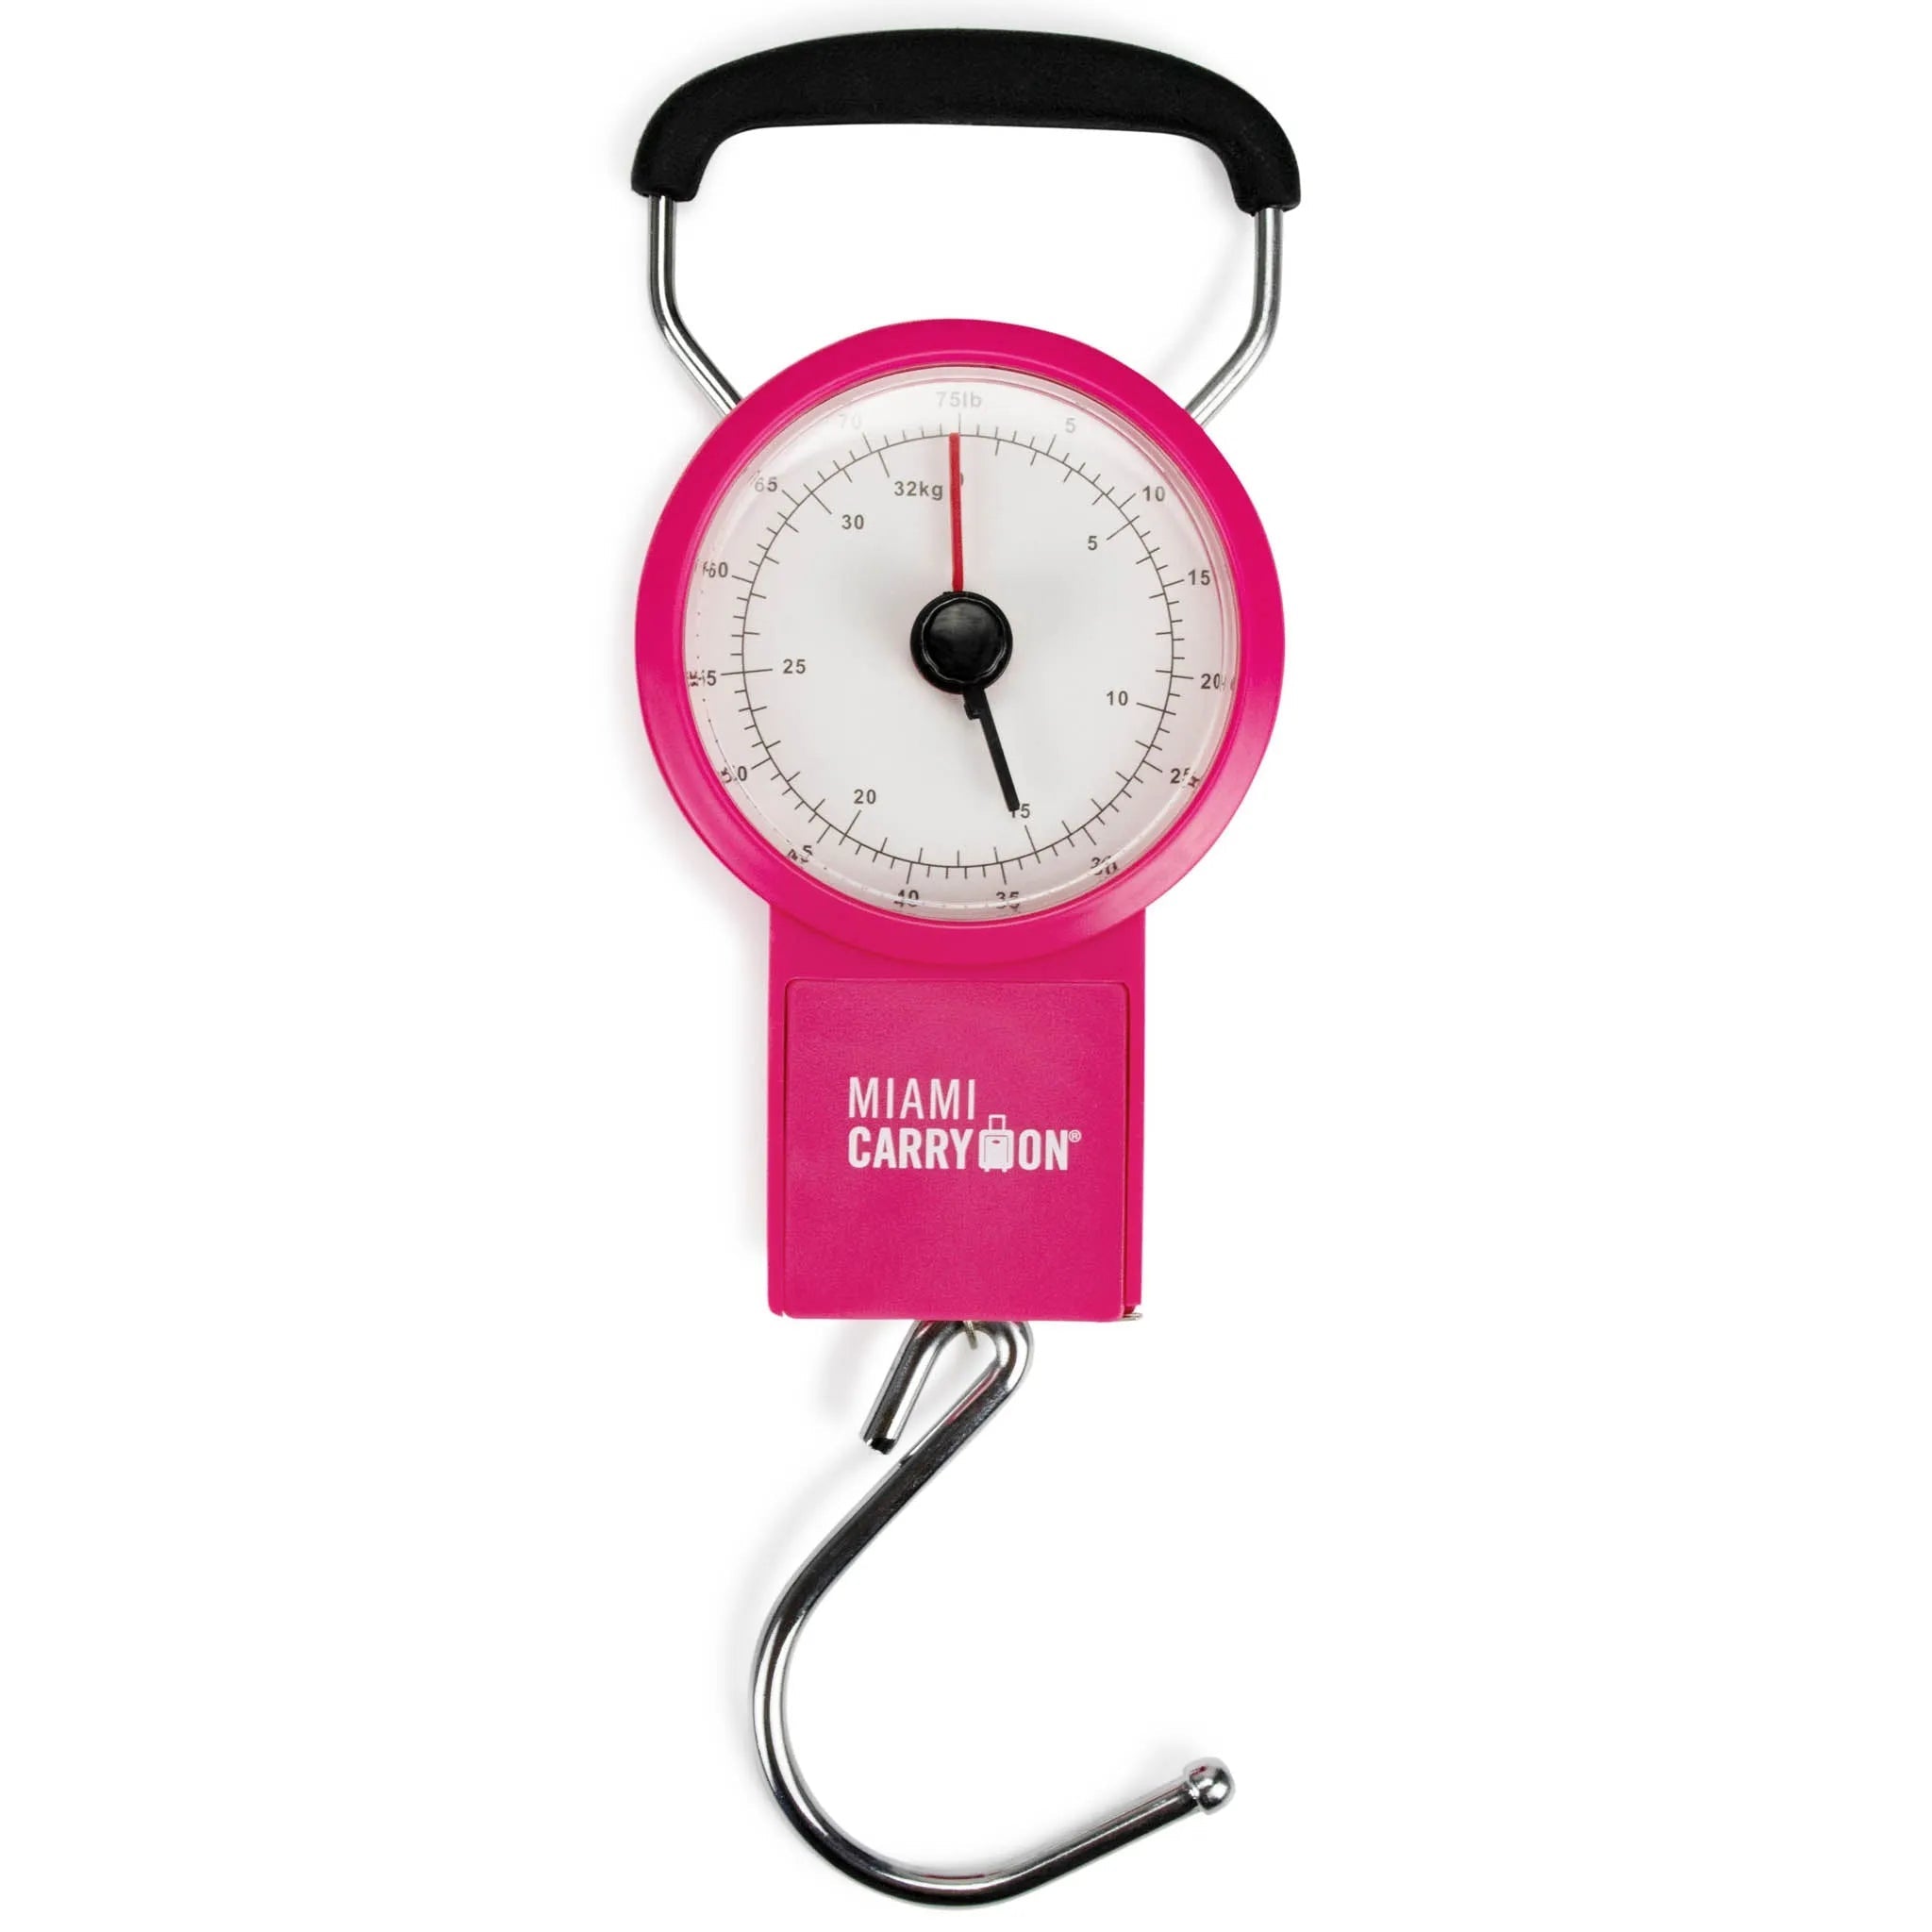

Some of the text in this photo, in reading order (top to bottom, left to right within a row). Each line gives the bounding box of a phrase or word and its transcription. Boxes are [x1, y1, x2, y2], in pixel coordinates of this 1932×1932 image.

[936, 391, 982, 408] 75lb
[839, 413, 863, 430] 70
[1064, 418, 1077, 434] 5
[754, 475, 778, 493] 65
[893, 480, 944, 501] 32kg
[1141, 485, 1167, 502] 10
[841, 513, 865, 530] 30
[1086, 535, 1099, 551] 5
[1187, 569, 1211, 586] 15
[782, 658, 807, 675] 25
[1200, 673, 1223, 691] 20
[1106, 690, 1129, 707] 10
[853, 789, 877, 805] 20
[848, 1076, 975, 1120] MIAMI
[848, 1126, 974, 1170] CARRY
